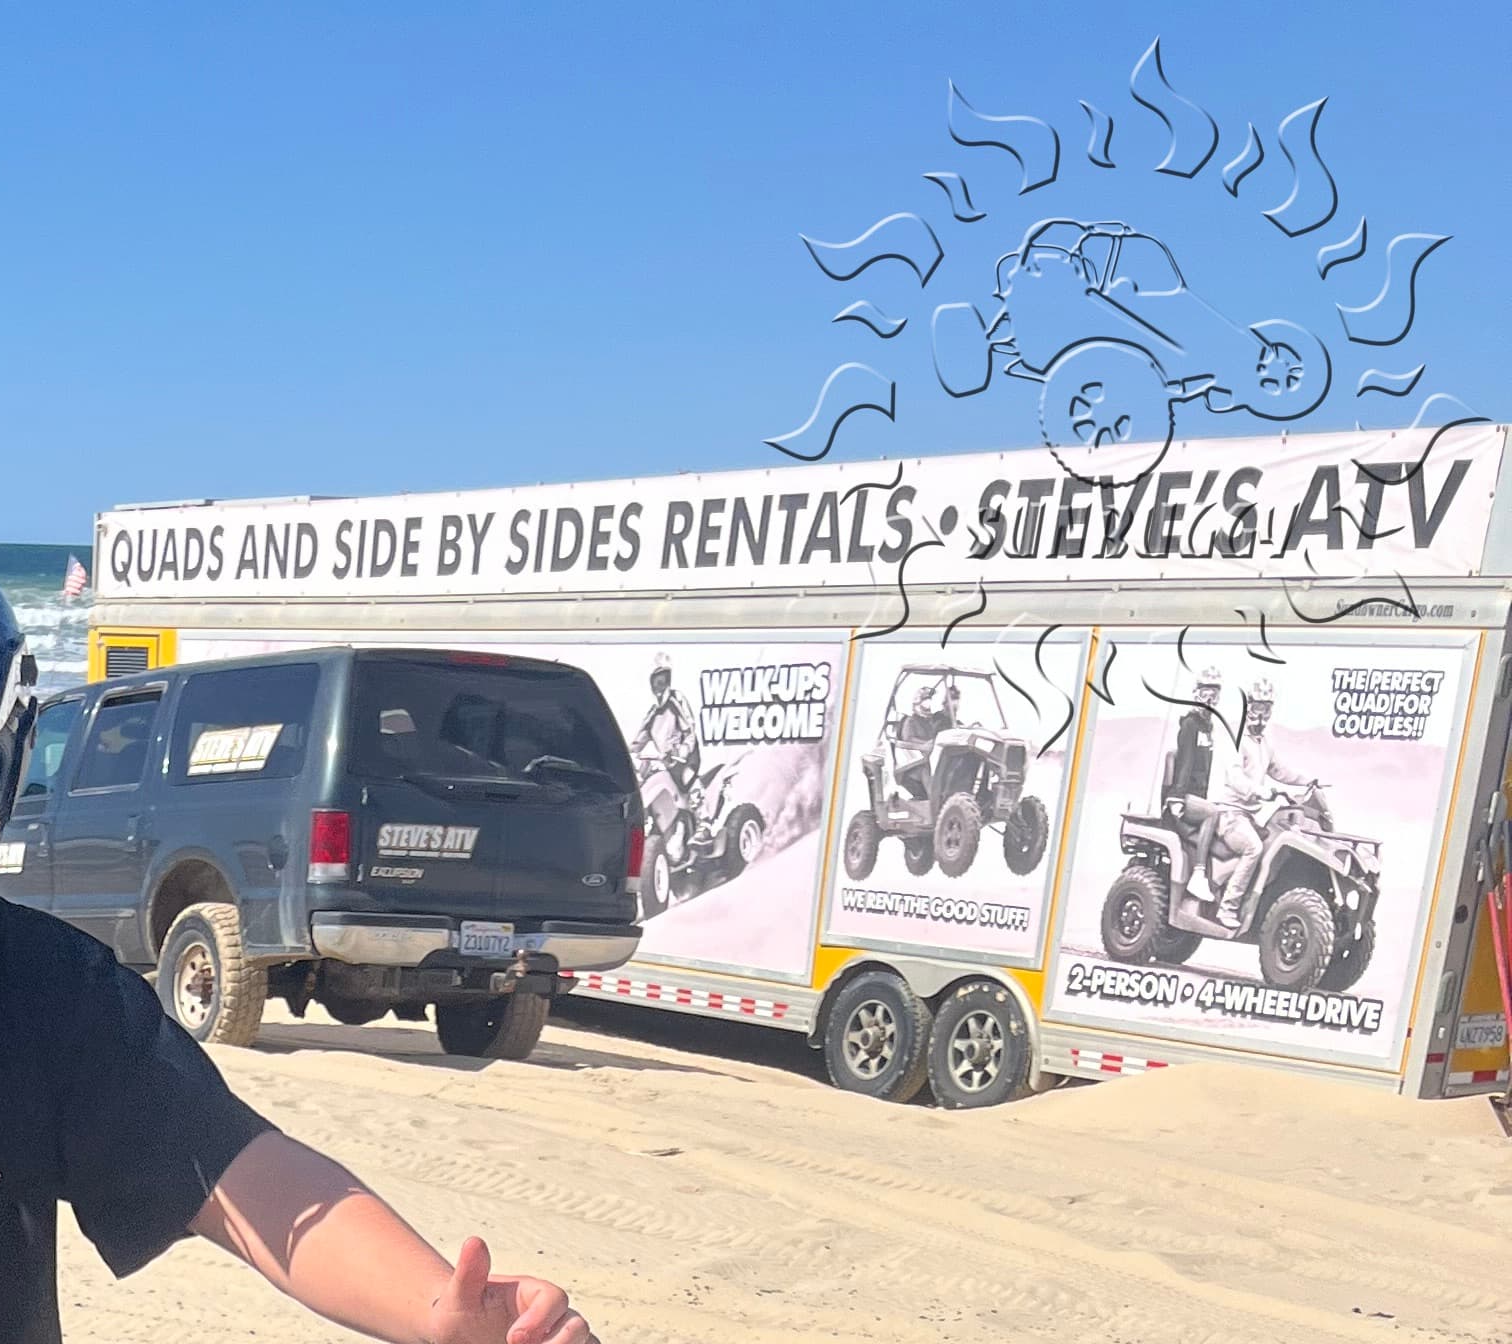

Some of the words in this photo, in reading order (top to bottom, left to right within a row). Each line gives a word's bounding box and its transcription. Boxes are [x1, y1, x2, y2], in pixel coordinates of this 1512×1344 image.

[111, 525, 225, 587] QUADS
[235, 522, 318, 579] AND
[332, 517, 423, 580] SIDE
[437, 513, 496, 577] BY
[504, 501, 643, 575] SIDES
[660, 485, 918, 569] RENTALS
[974, 466, 1264, 560] STEVE'S
[1287, 459, 1474, 551] ATV
[700, 661, 831, 705] WALK-UPS
[1332, 668, 1369, 692] THE
[1369, 669, 1444, 695] PERFECT
[700, 702, 826, 745] WELCOME
[1335, 691, 1392, 715] QUAD
[1393, 693, 1433, 716] FOR
[1332, 713, 1427, 741] COUPLES!!
[378, 823, 444, 849] STEVE'S
[443, 826, 480, 850] ATV
[842, 888, 866, 911] WE
[865, 890, 903, 917] RENT
[902, 895, 929, 919] THE
[930, 897, 978, 925] GOOD
[979, 903, 1030, 931] STUFF!
[1066, 964, 1179, 1006] 2-PERSON
[1195, 980, 1303, 1023] 4-WHEEL
[1304, 994, 1384, 1035] DRIVE
